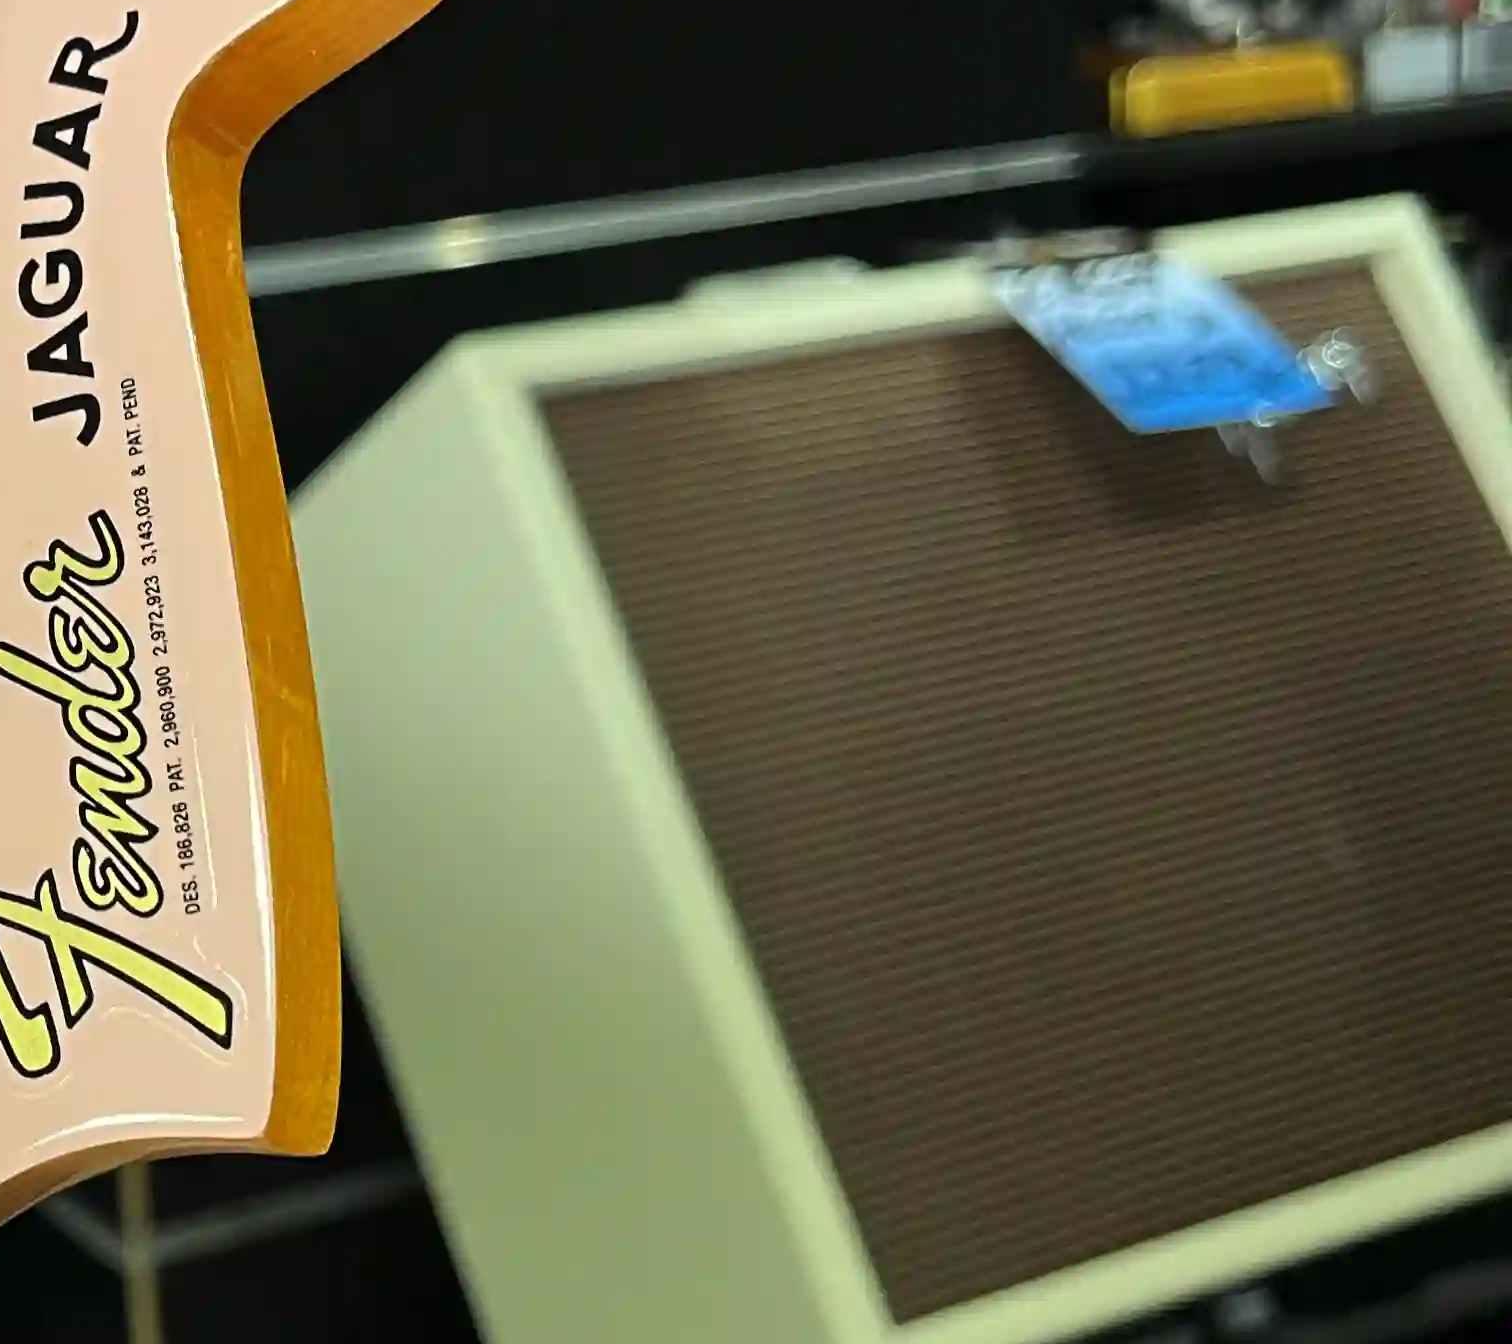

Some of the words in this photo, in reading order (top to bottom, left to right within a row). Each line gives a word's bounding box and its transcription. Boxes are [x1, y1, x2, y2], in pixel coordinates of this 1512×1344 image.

[18, 10, 139, 447] JAGUAR
[120, 377, 139, 421] PEND
[126, 423, 143, 457] PAT.
[130, 464, 146, 477] &
[132, 486, 157, 567] 3,143,028
[143, 575, 168, 656] 2,972,923
[155, 666, 181, 748] 2,960,900
[166, 757, 185, 793] PAT.
[172, 802, 195, 871] 186,826
[181, 875, 201, 916] DES.
